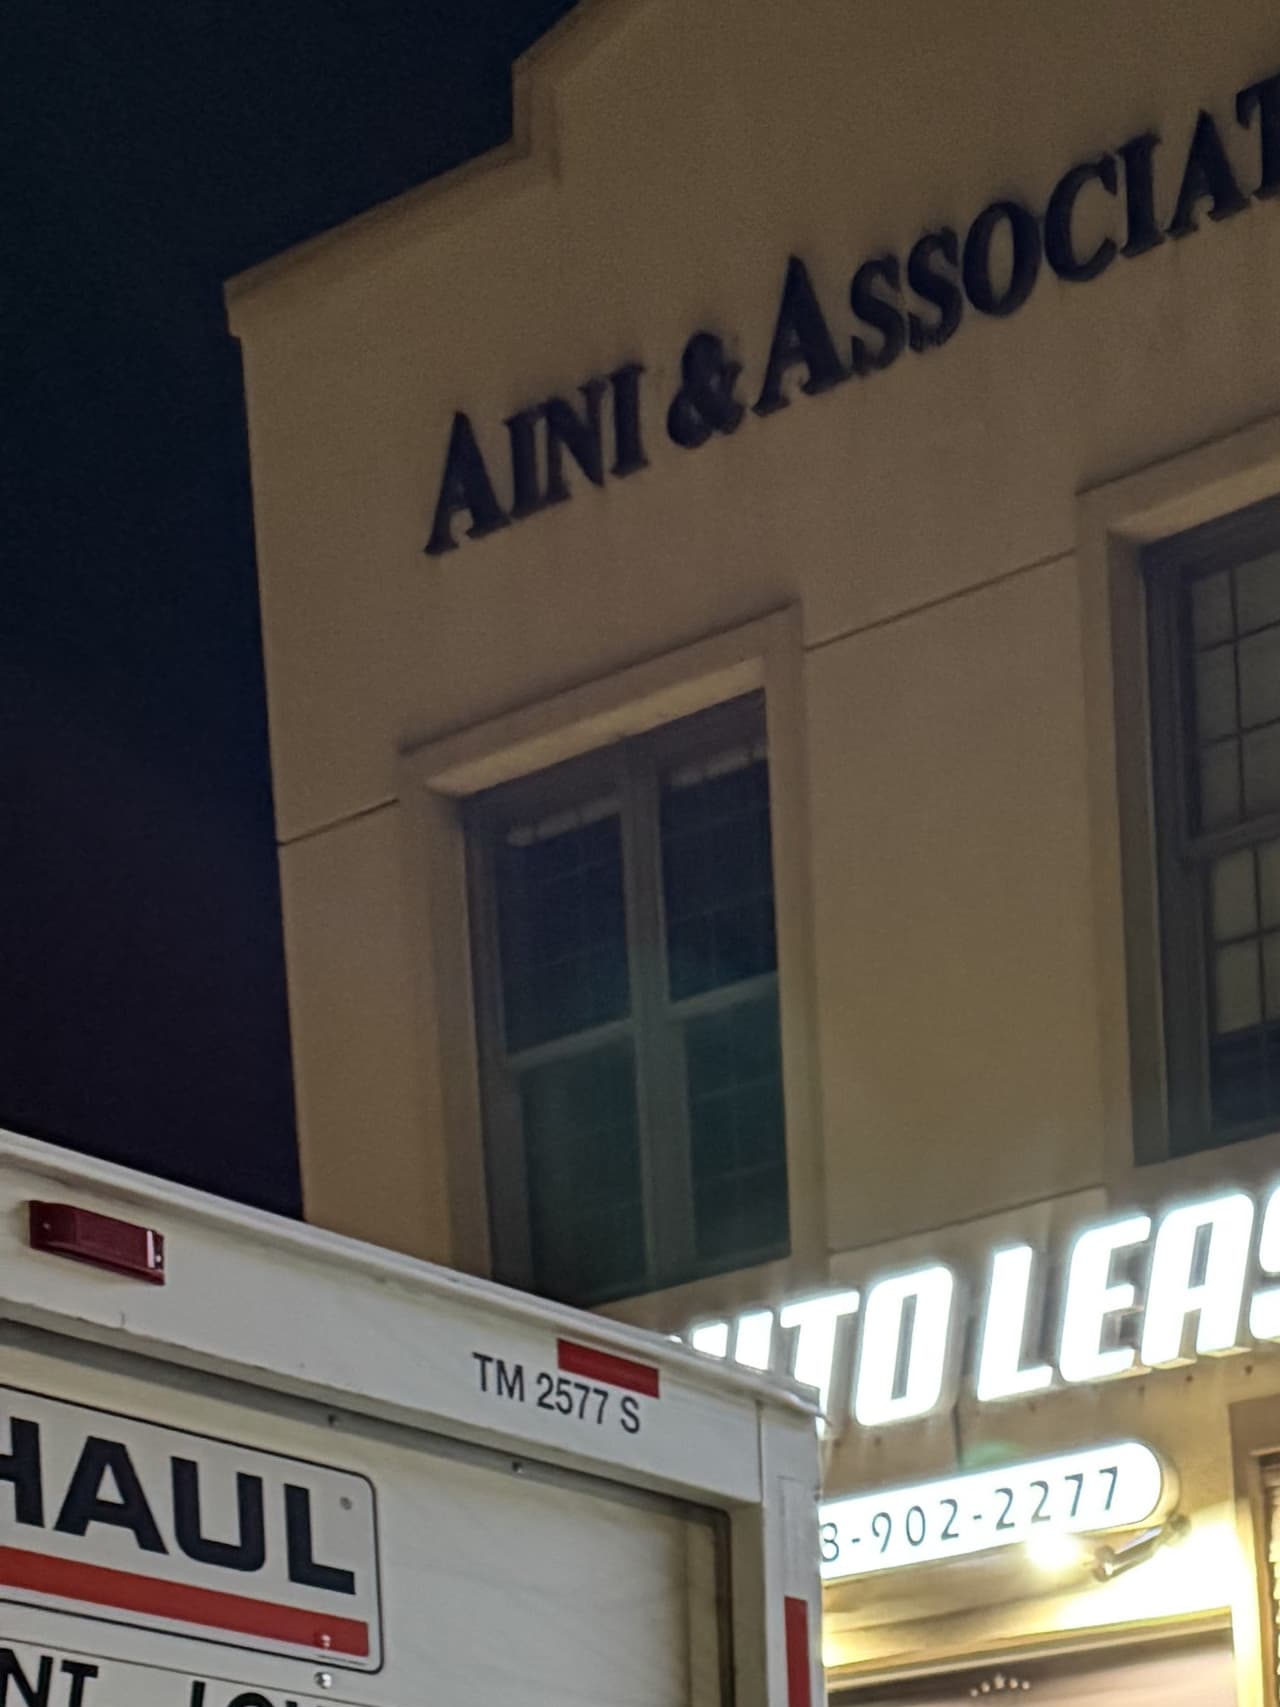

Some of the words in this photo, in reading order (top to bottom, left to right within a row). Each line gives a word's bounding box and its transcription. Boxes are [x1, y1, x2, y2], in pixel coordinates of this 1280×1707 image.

[424, 362, 652, 556] AINI
[665, 331, 747, 449] &
[473, 1352, 526, 1401] TM
[536, 1373, 608, 1424] 2577
[621, 1395, 641, 1434] S
[672, 1262, 955, 1432] TO
